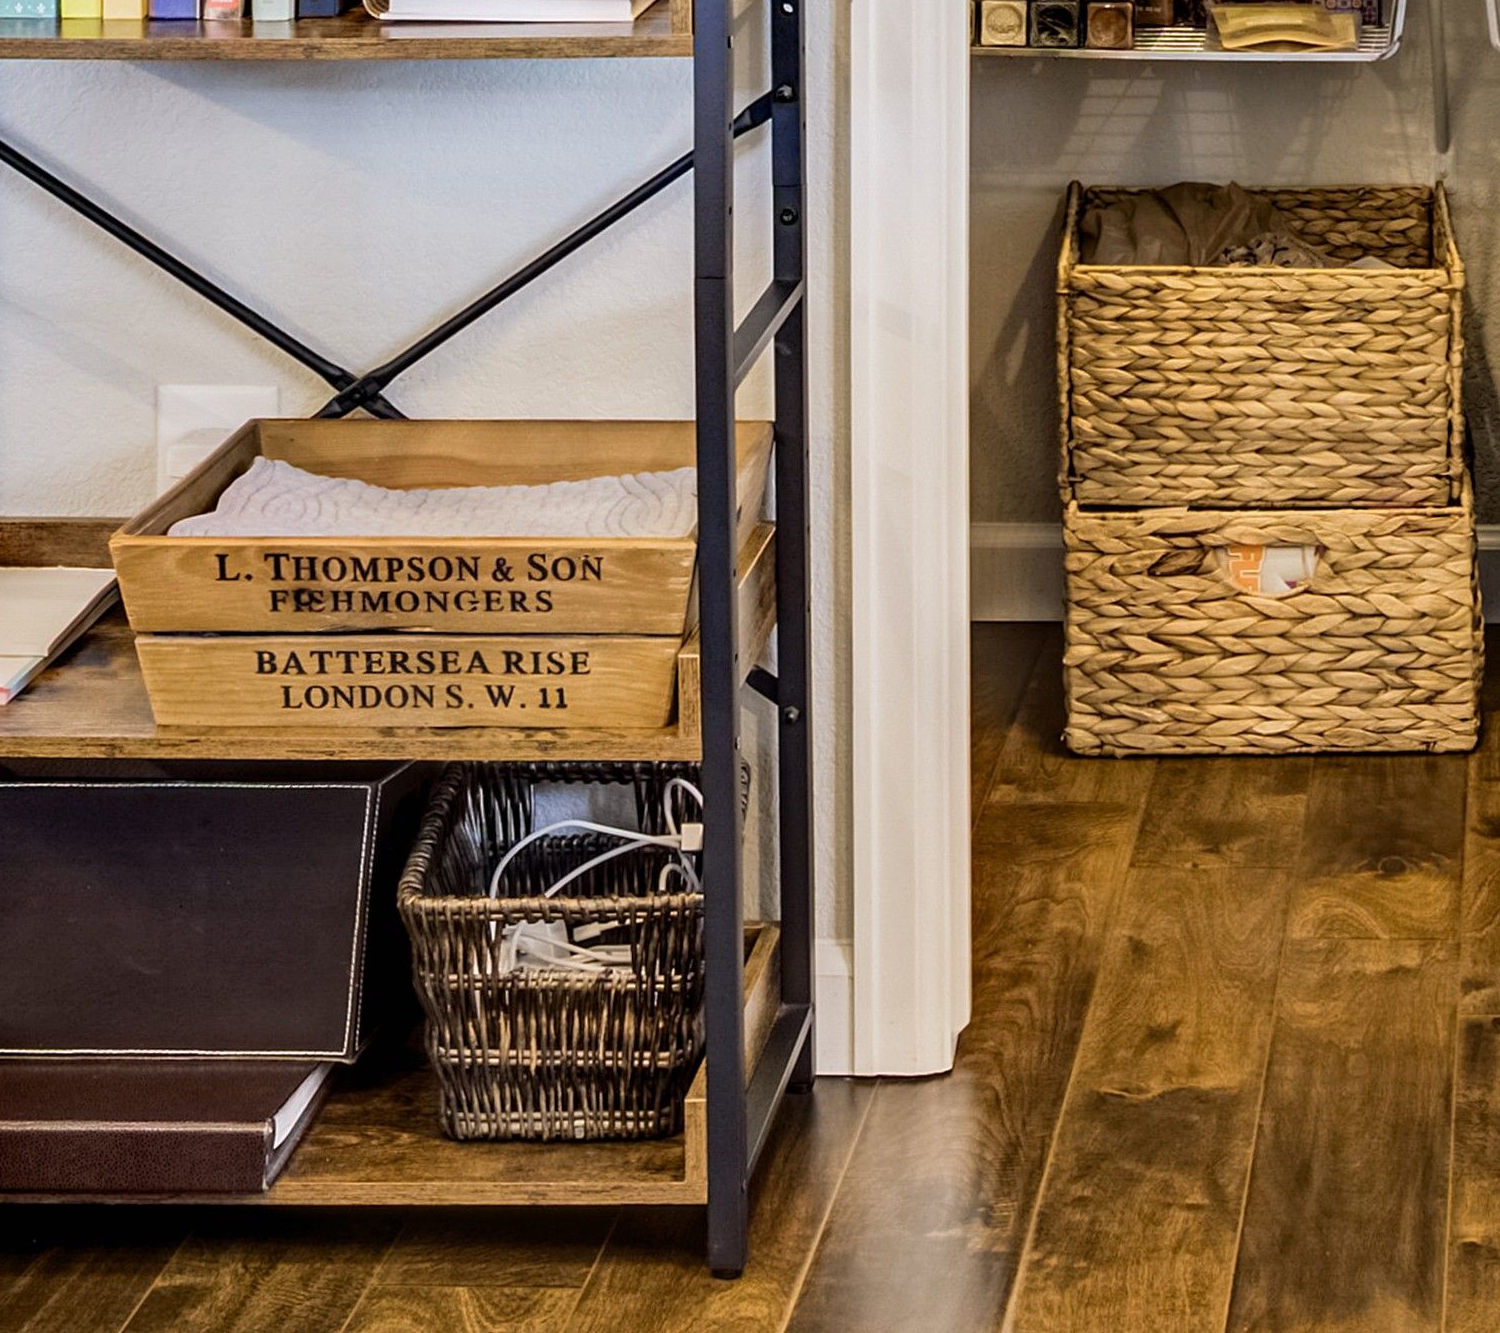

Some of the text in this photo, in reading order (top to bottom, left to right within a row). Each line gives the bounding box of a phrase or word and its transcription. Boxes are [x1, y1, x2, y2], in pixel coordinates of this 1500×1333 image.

[215, 553, 604, 583] L. THOMPSON & SON
[268, 590, 554, 613] FISHMONGERS
[255, 650, 591, 675] BATTERSEA RISE
[280, 684, 568, 709] LONDON S. W. 11
